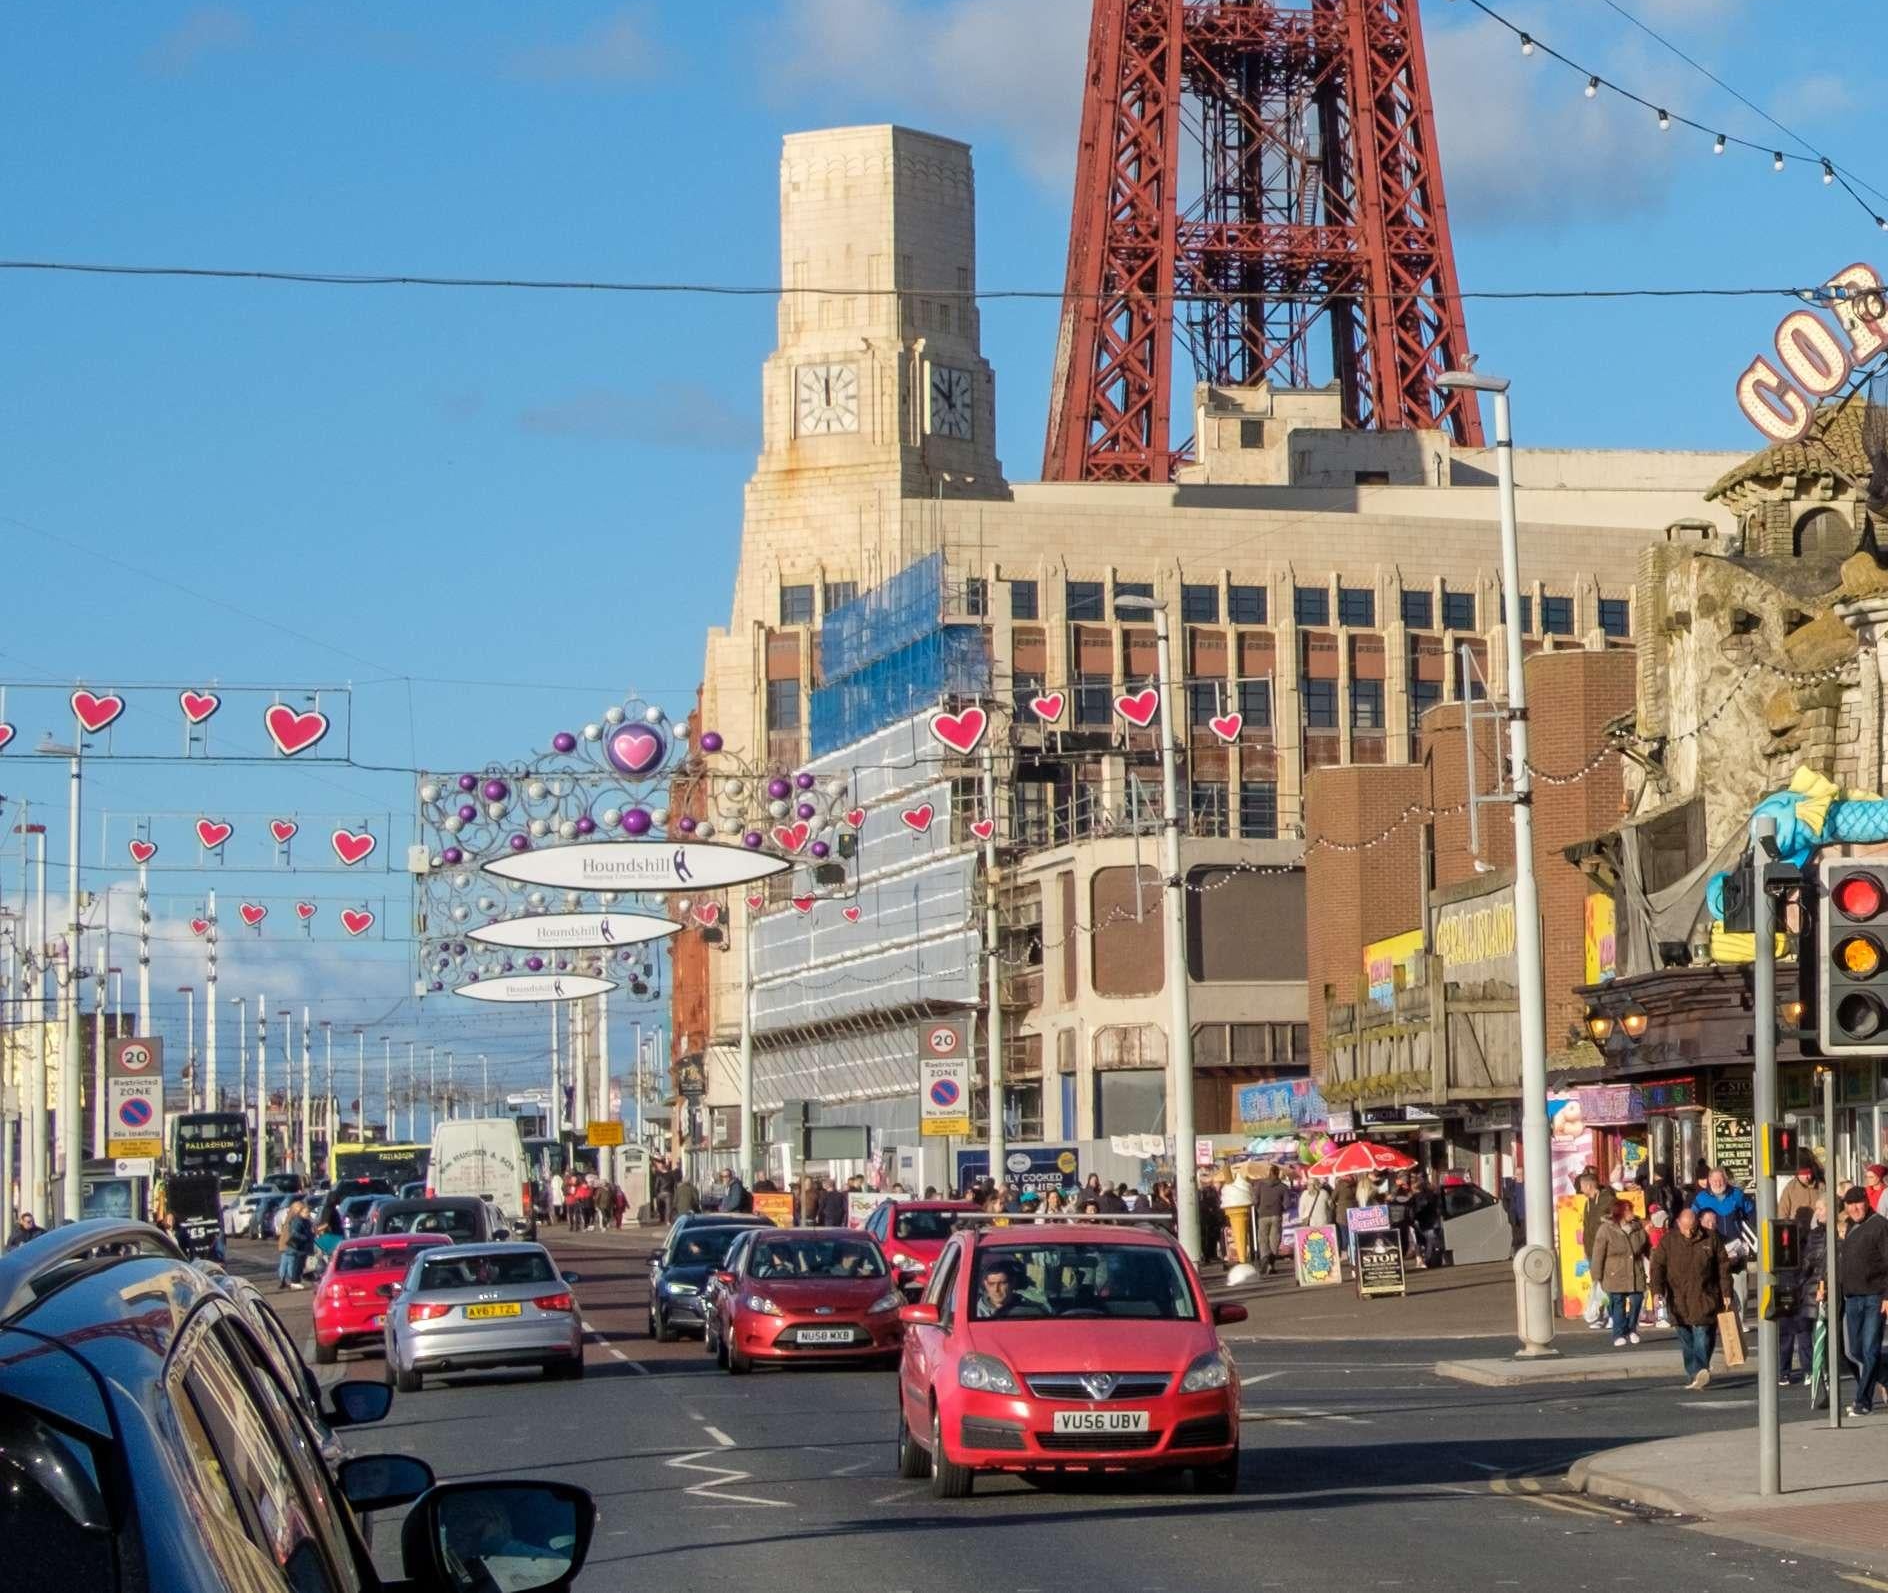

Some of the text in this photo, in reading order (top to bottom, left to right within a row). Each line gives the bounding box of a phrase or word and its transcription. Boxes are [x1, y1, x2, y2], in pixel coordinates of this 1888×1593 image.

[583, 858, 670, 874] Houndshill
[537, 926, 599, 938] Houndshill
[934, 1035, 954, 1046] 20
[125, 1051, 147, 1063] 20
[931, 1069, 957, 1077] ZONE
[120, 1088, 152, 1096] ZONE
[1720, 1159, 1748, 1167] ADVICE
[1022, 1173, 1062, 1183] COOKED
[1363, 1254, 1398, 1263] STOP
[802, 1331, 828, 1340] NU58
[1063, 1414, 1141, 1428] VU56 UBV
